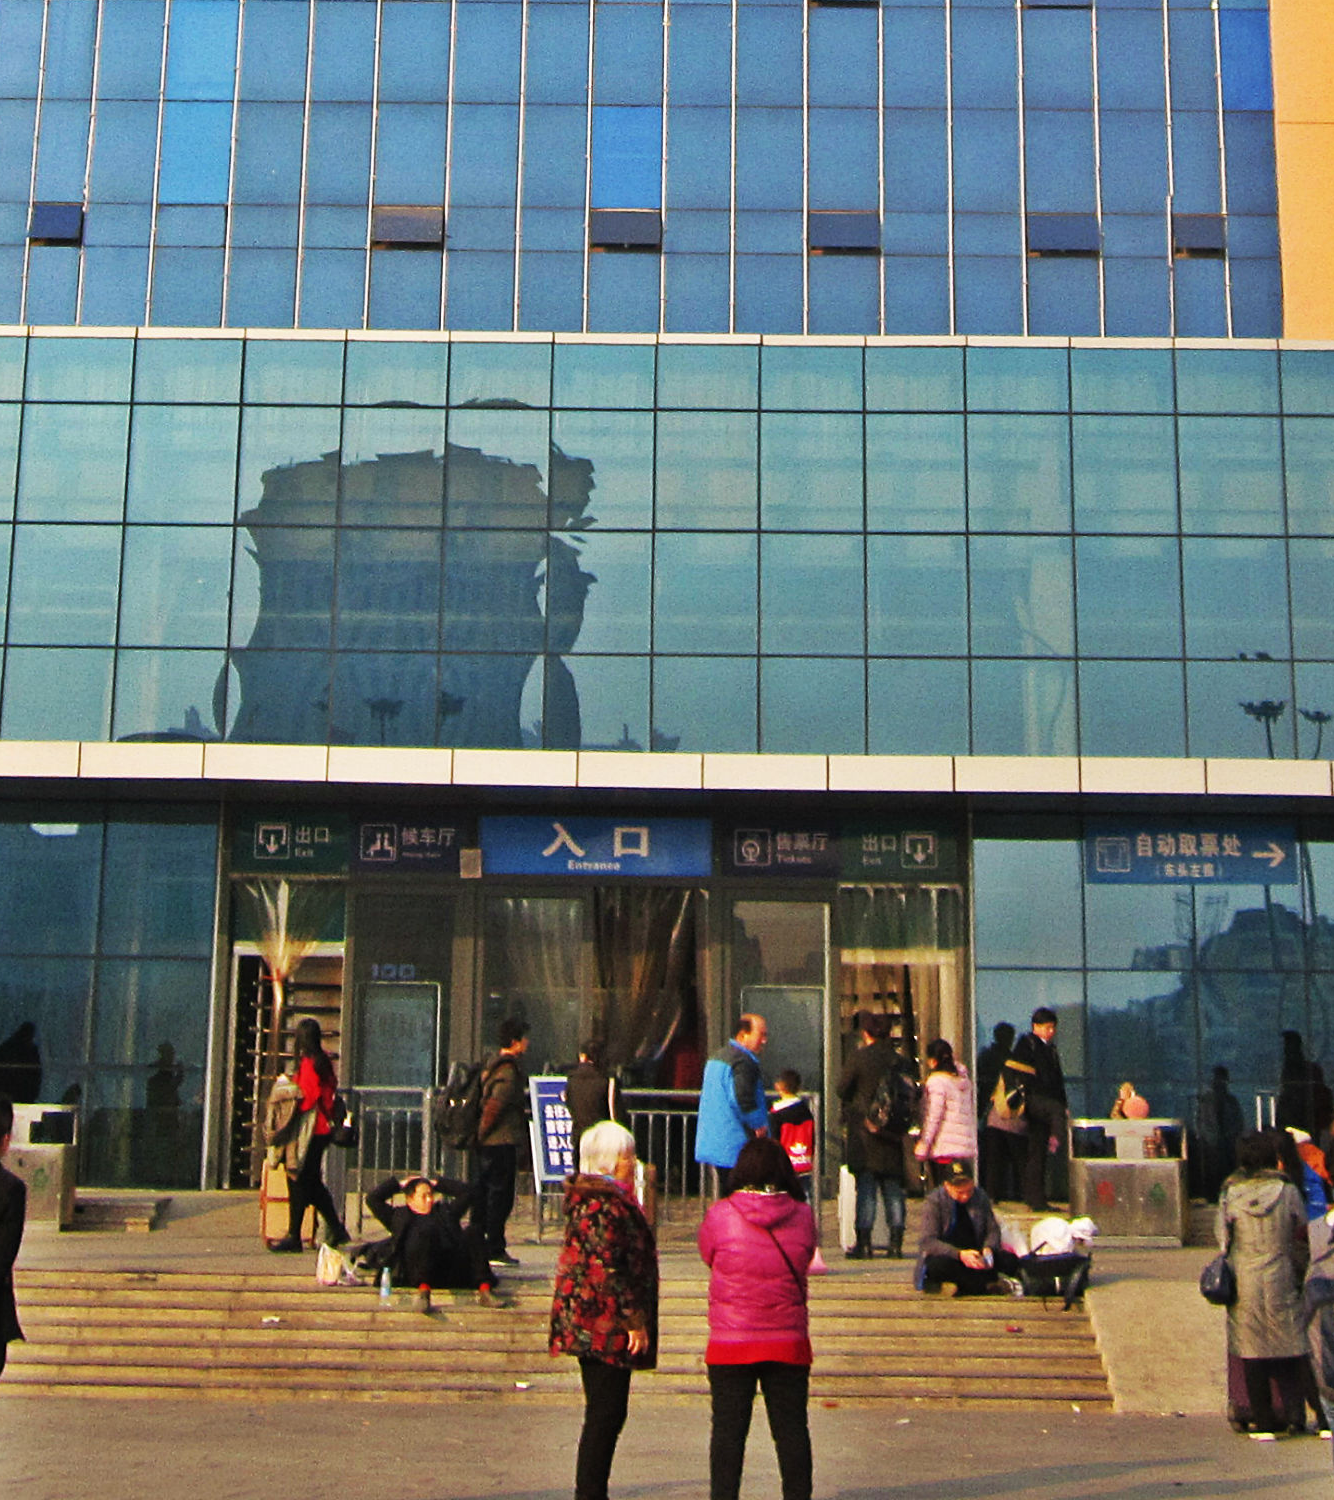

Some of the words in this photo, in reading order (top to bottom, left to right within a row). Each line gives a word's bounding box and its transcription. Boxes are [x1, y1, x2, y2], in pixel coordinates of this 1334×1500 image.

[295, 826, 329, 844] 出口
[402, 826, 456, 847] 候车厅
[541, 822, 649, 857] 入口
[776, 832, 828, 851] 售票厅
[862, 834, 897, 852] 出口
[1136, 833, 1242, 857] 自动取票处
[567, 859, 621, 871] Entrance
